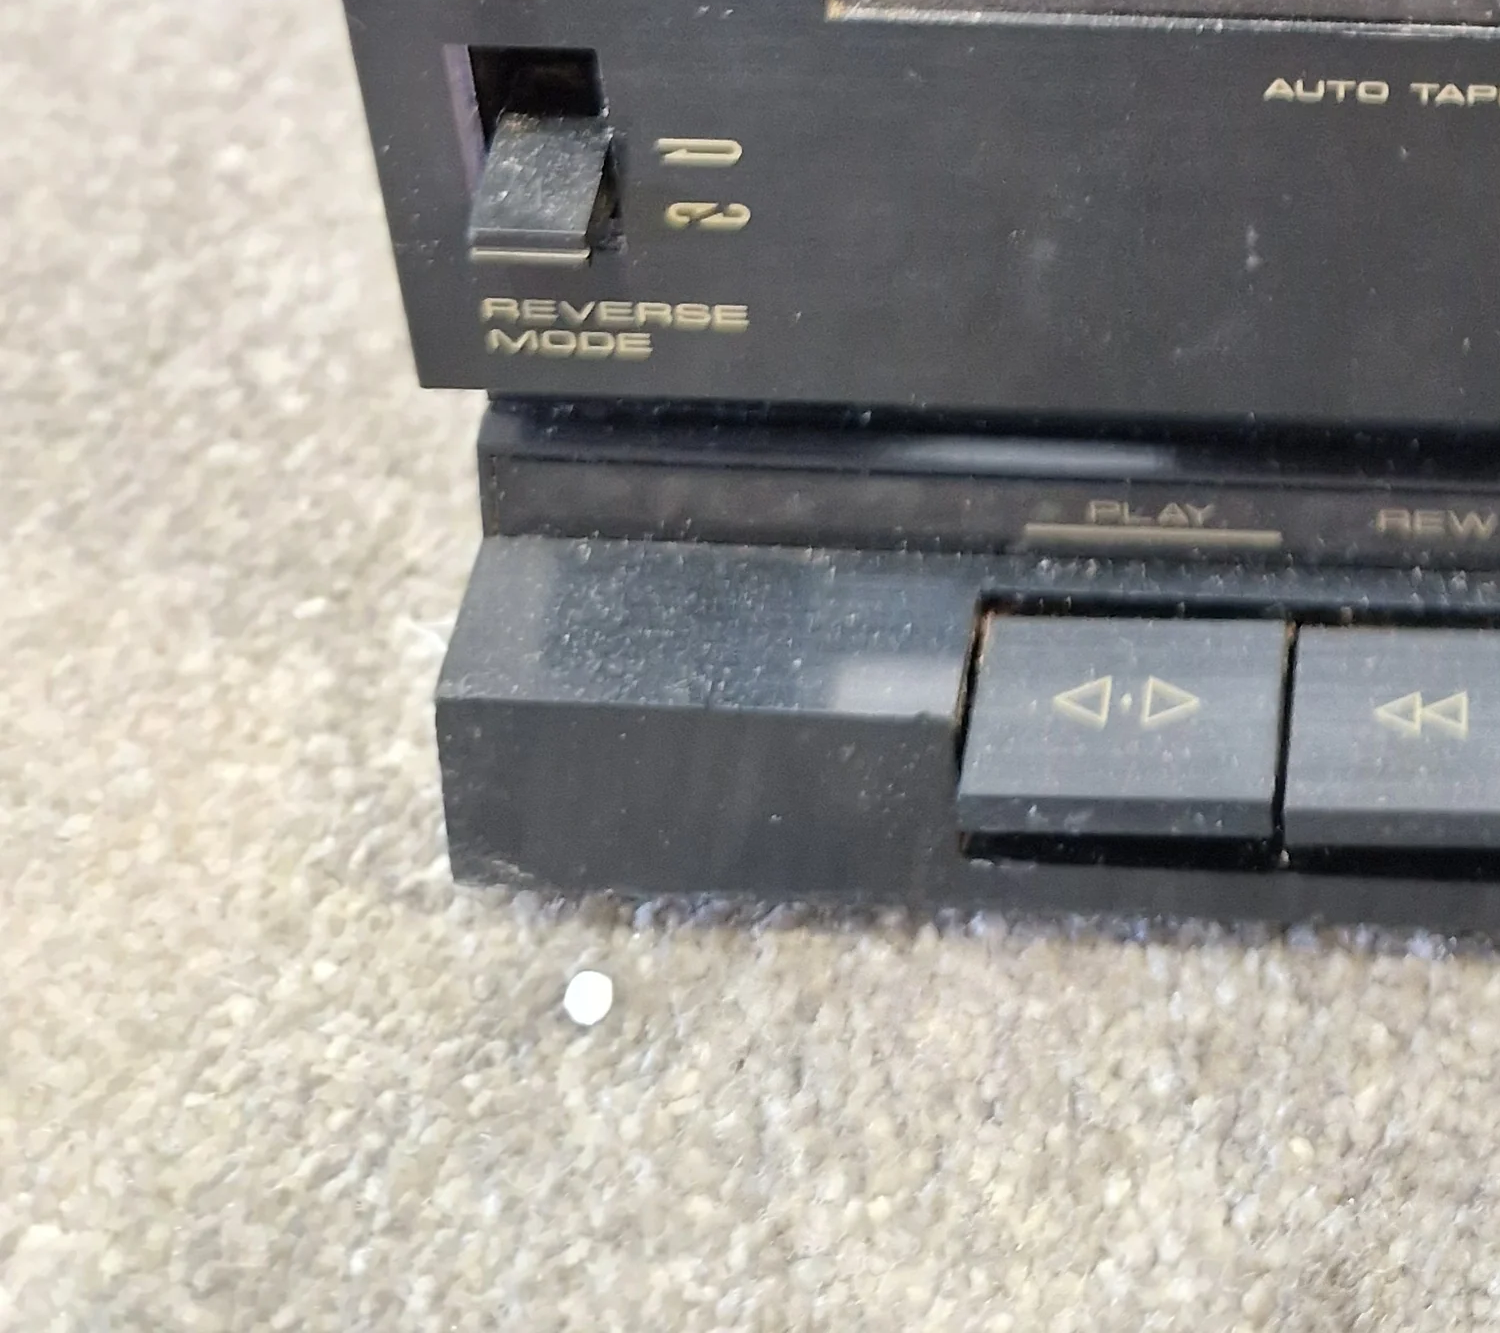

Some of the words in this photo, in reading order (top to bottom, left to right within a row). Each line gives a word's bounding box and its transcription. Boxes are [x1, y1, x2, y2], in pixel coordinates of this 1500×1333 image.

[1263, 77, 1390, 103] AUTO
[481, 297, 750, 330] REVERSE
[487, 328, 653, 357] MODE
[1087, 499, 1215, 528] PLAY
[1375, 508, 1498, 539] REW
